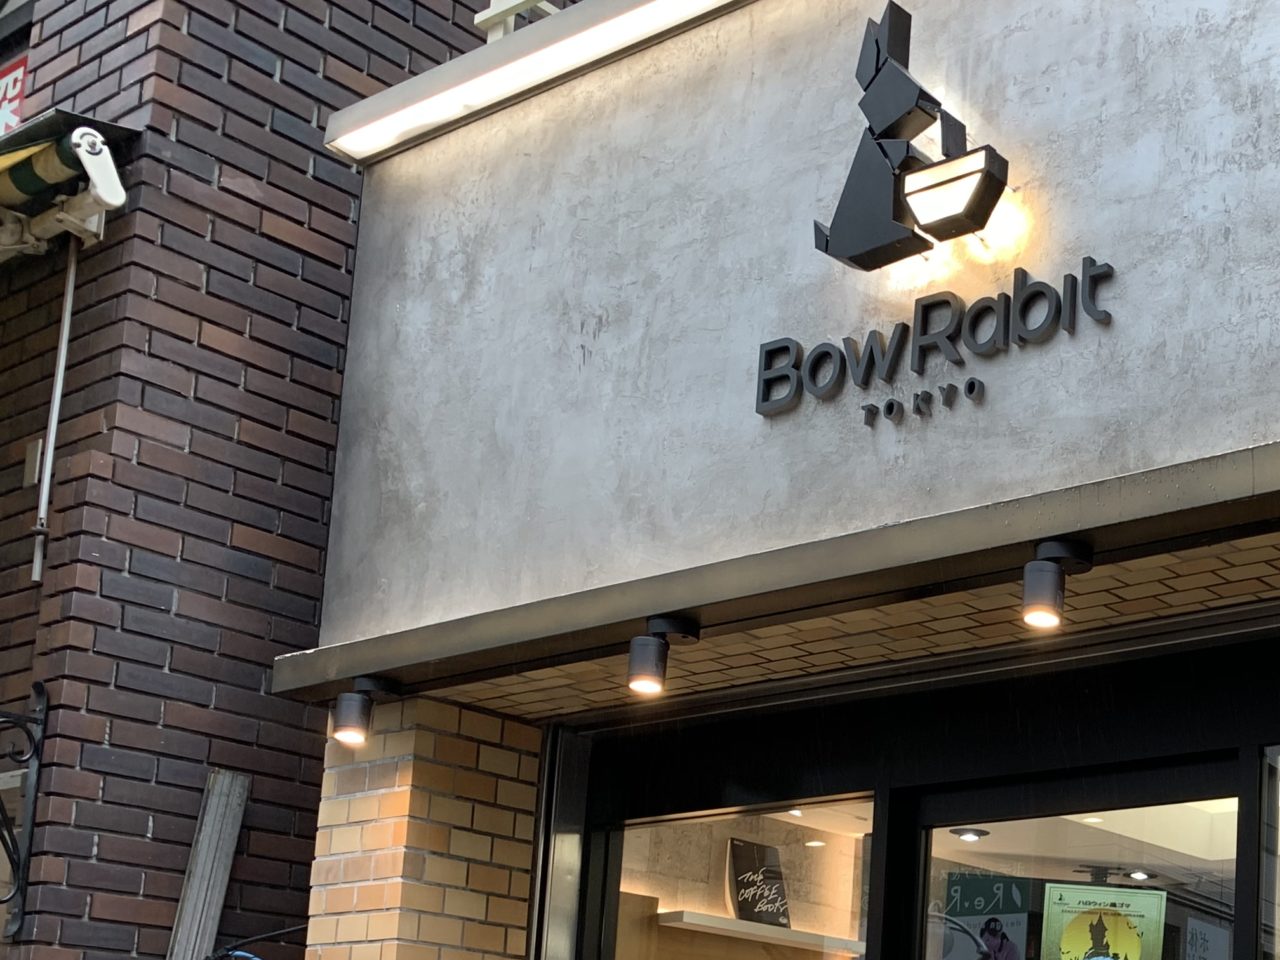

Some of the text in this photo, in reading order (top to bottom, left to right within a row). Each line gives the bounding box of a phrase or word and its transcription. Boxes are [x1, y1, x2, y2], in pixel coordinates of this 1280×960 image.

[755, 256, 1114, 418] BowRabit
[861, 377, 985, 427] TOKYO
[738, 867, 767, 885] THE
[738, 884, 780, 902] COFFEE
